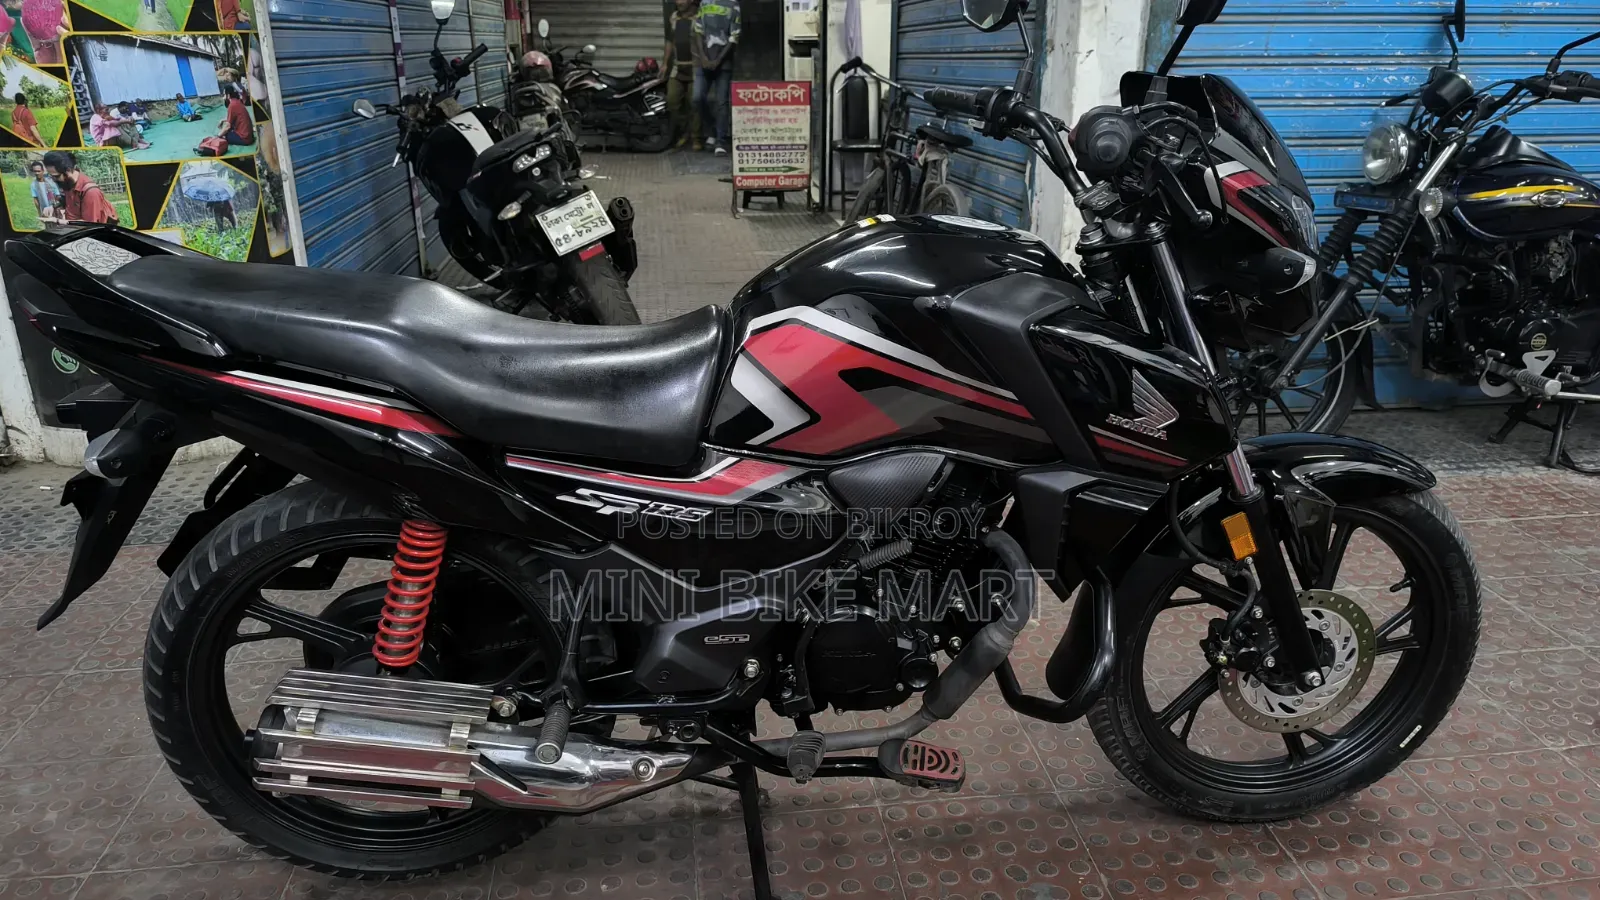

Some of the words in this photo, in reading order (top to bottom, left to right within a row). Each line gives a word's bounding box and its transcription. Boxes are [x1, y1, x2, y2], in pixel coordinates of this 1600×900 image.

[736, 84, 806, 103] ফটোকপি
[735, 176, 777, 188] Computer
[778, 175, 809, 188] Garage
[1105, 413, 1168, 441] HONDA
